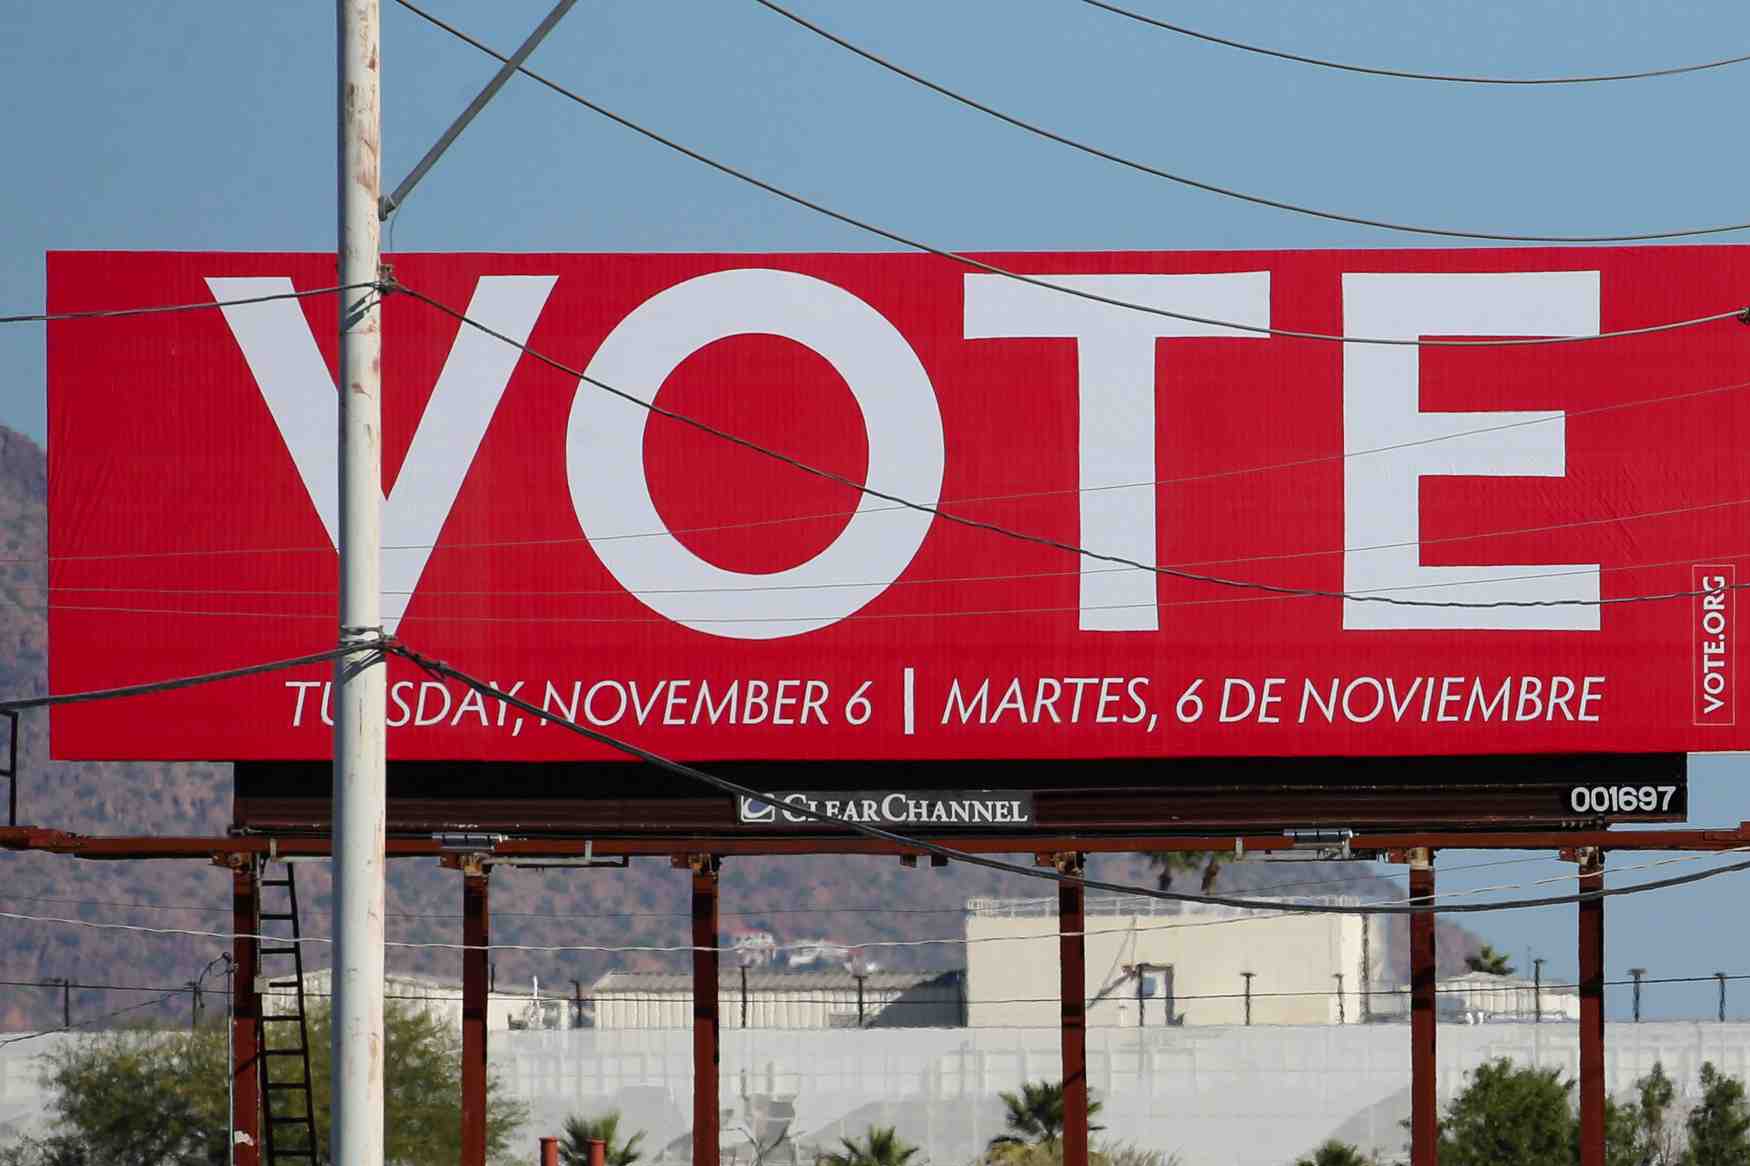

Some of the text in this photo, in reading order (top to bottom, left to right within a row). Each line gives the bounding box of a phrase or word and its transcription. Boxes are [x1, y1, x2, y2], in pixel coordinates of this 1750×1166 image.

[204, 267, 1601, 641] VOTE
[1702, 575, 1726, 714] VOTE.ORG
[539, 679, 829, 726] NOVEMBER
[845, 680, 873, 726] 6
[941, 677, 1158, 733] MARTES,
[1176, 678, 1204, 723] 6
[1218, 678, 1286, 724] DE
[1297, 676, 1606, 724] NOVIEMBRE
[1571, 786, 1677, 812] 001697
